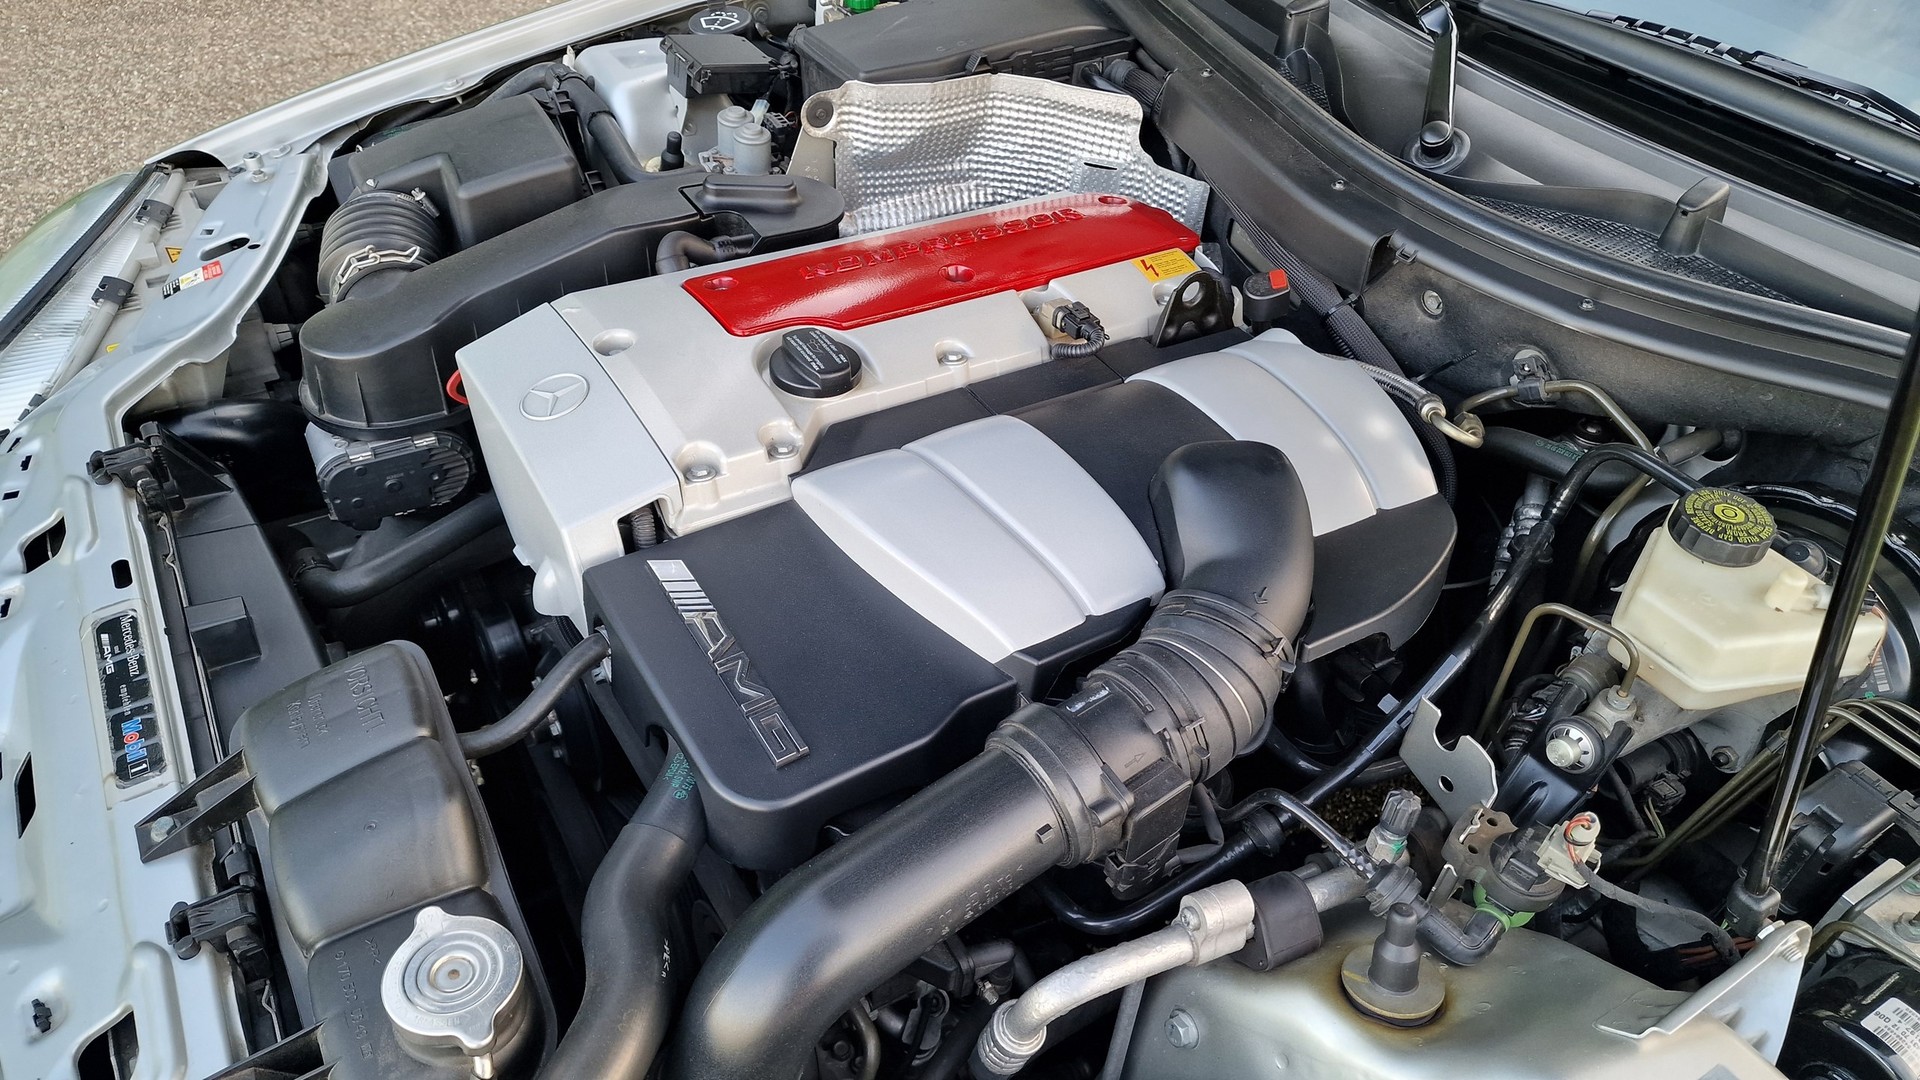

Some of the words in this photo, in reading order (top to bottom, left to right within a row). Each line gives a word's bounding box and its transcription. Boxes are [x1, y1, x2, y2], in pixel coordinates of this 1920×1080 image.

[800, 208, 1086, 280] KOMPRESSOR
[1690, 516, 1714, 534] BEFORE
[1718, 533, 1734, 542] CAP
[120, 614, 140, 677] Mercedes-Benz
[680, 611, 810, 769] AMG
[121, 717, 147, 762] Mobil
